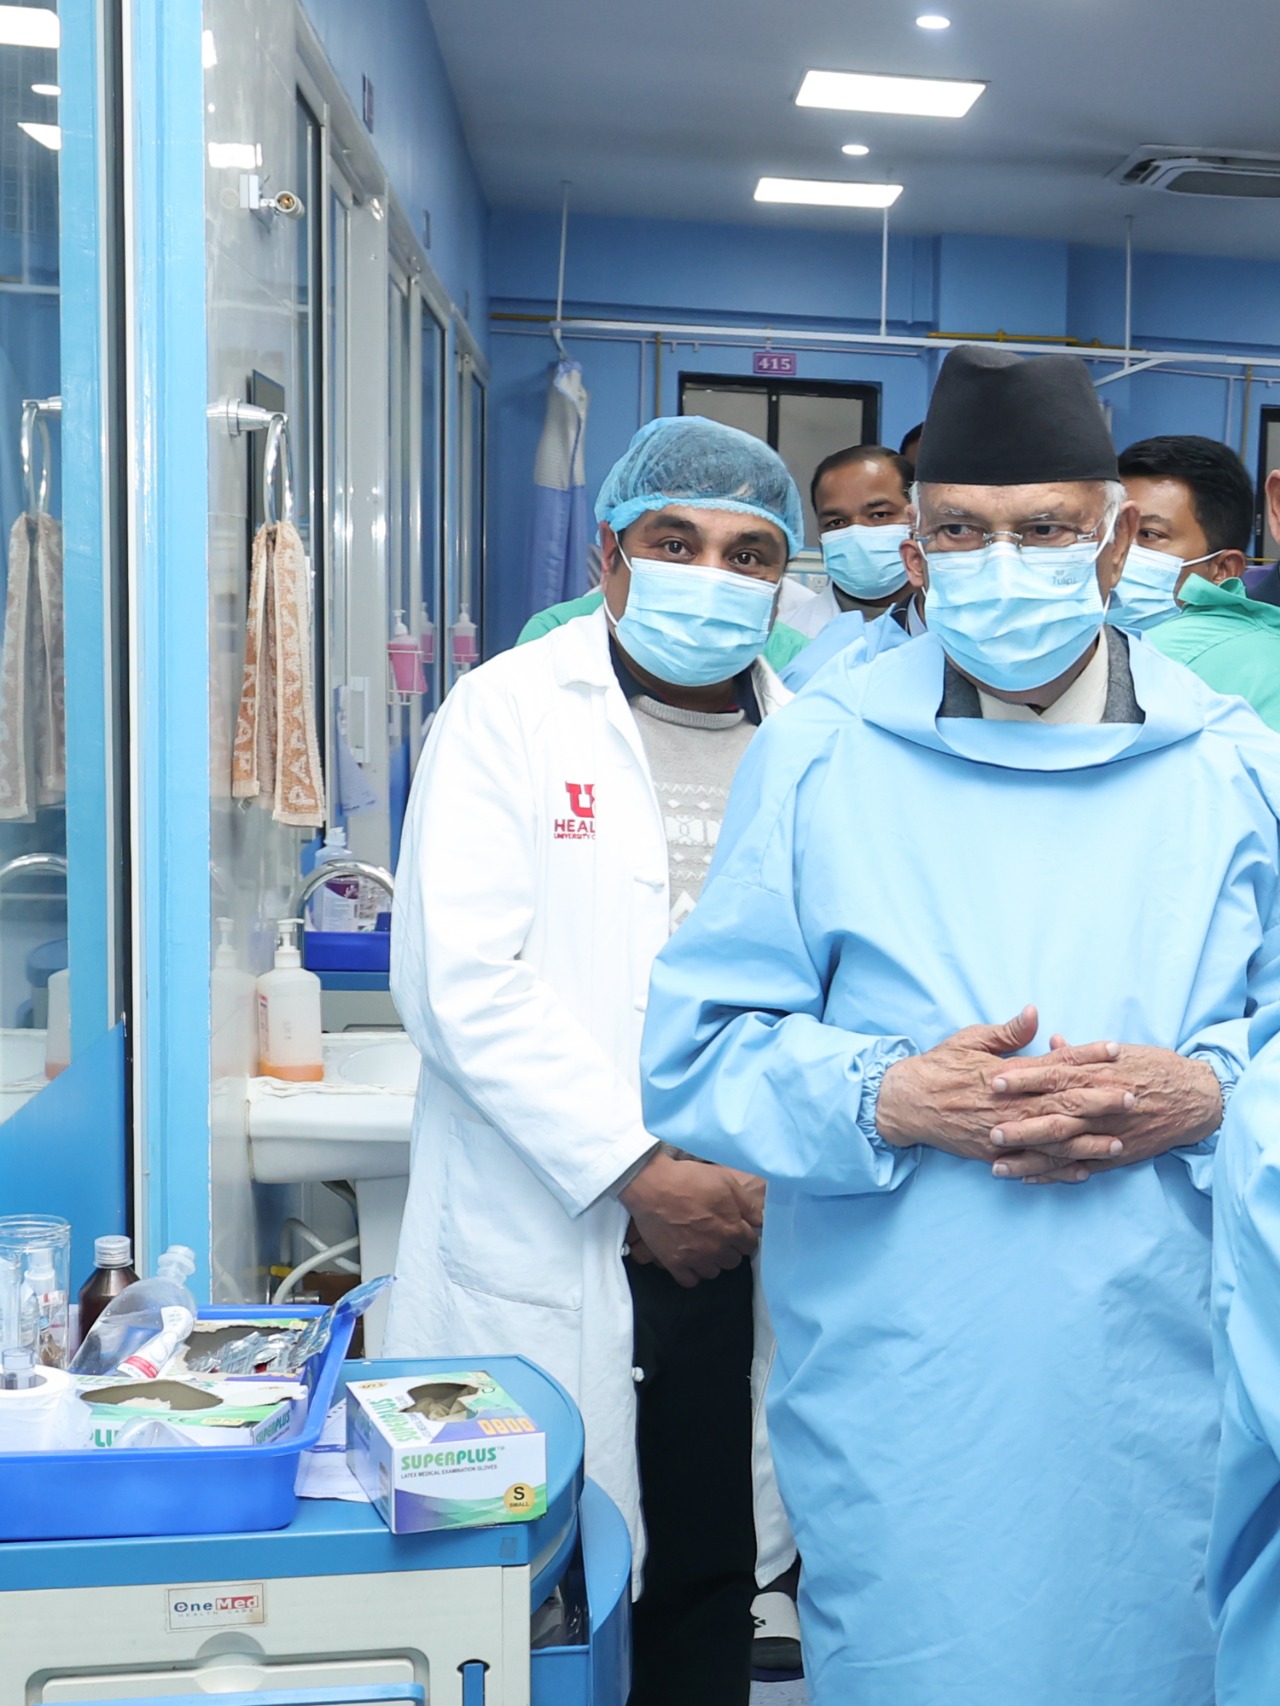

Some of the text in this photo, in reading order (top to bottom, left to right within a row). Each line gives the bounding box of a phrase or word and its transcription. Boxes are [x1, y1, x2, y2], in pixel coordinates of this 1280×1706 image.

[758, 357, 792, 371] 415
[554, 832, 590, 840] UNIVERSITY
[400, 1446, 497, 1471] SUPERPLUS
[401, 1463, 498, 1479] LATEX MEDICAL EXAMINATION GLOVES
[513, 1486, 525, 1501] S
